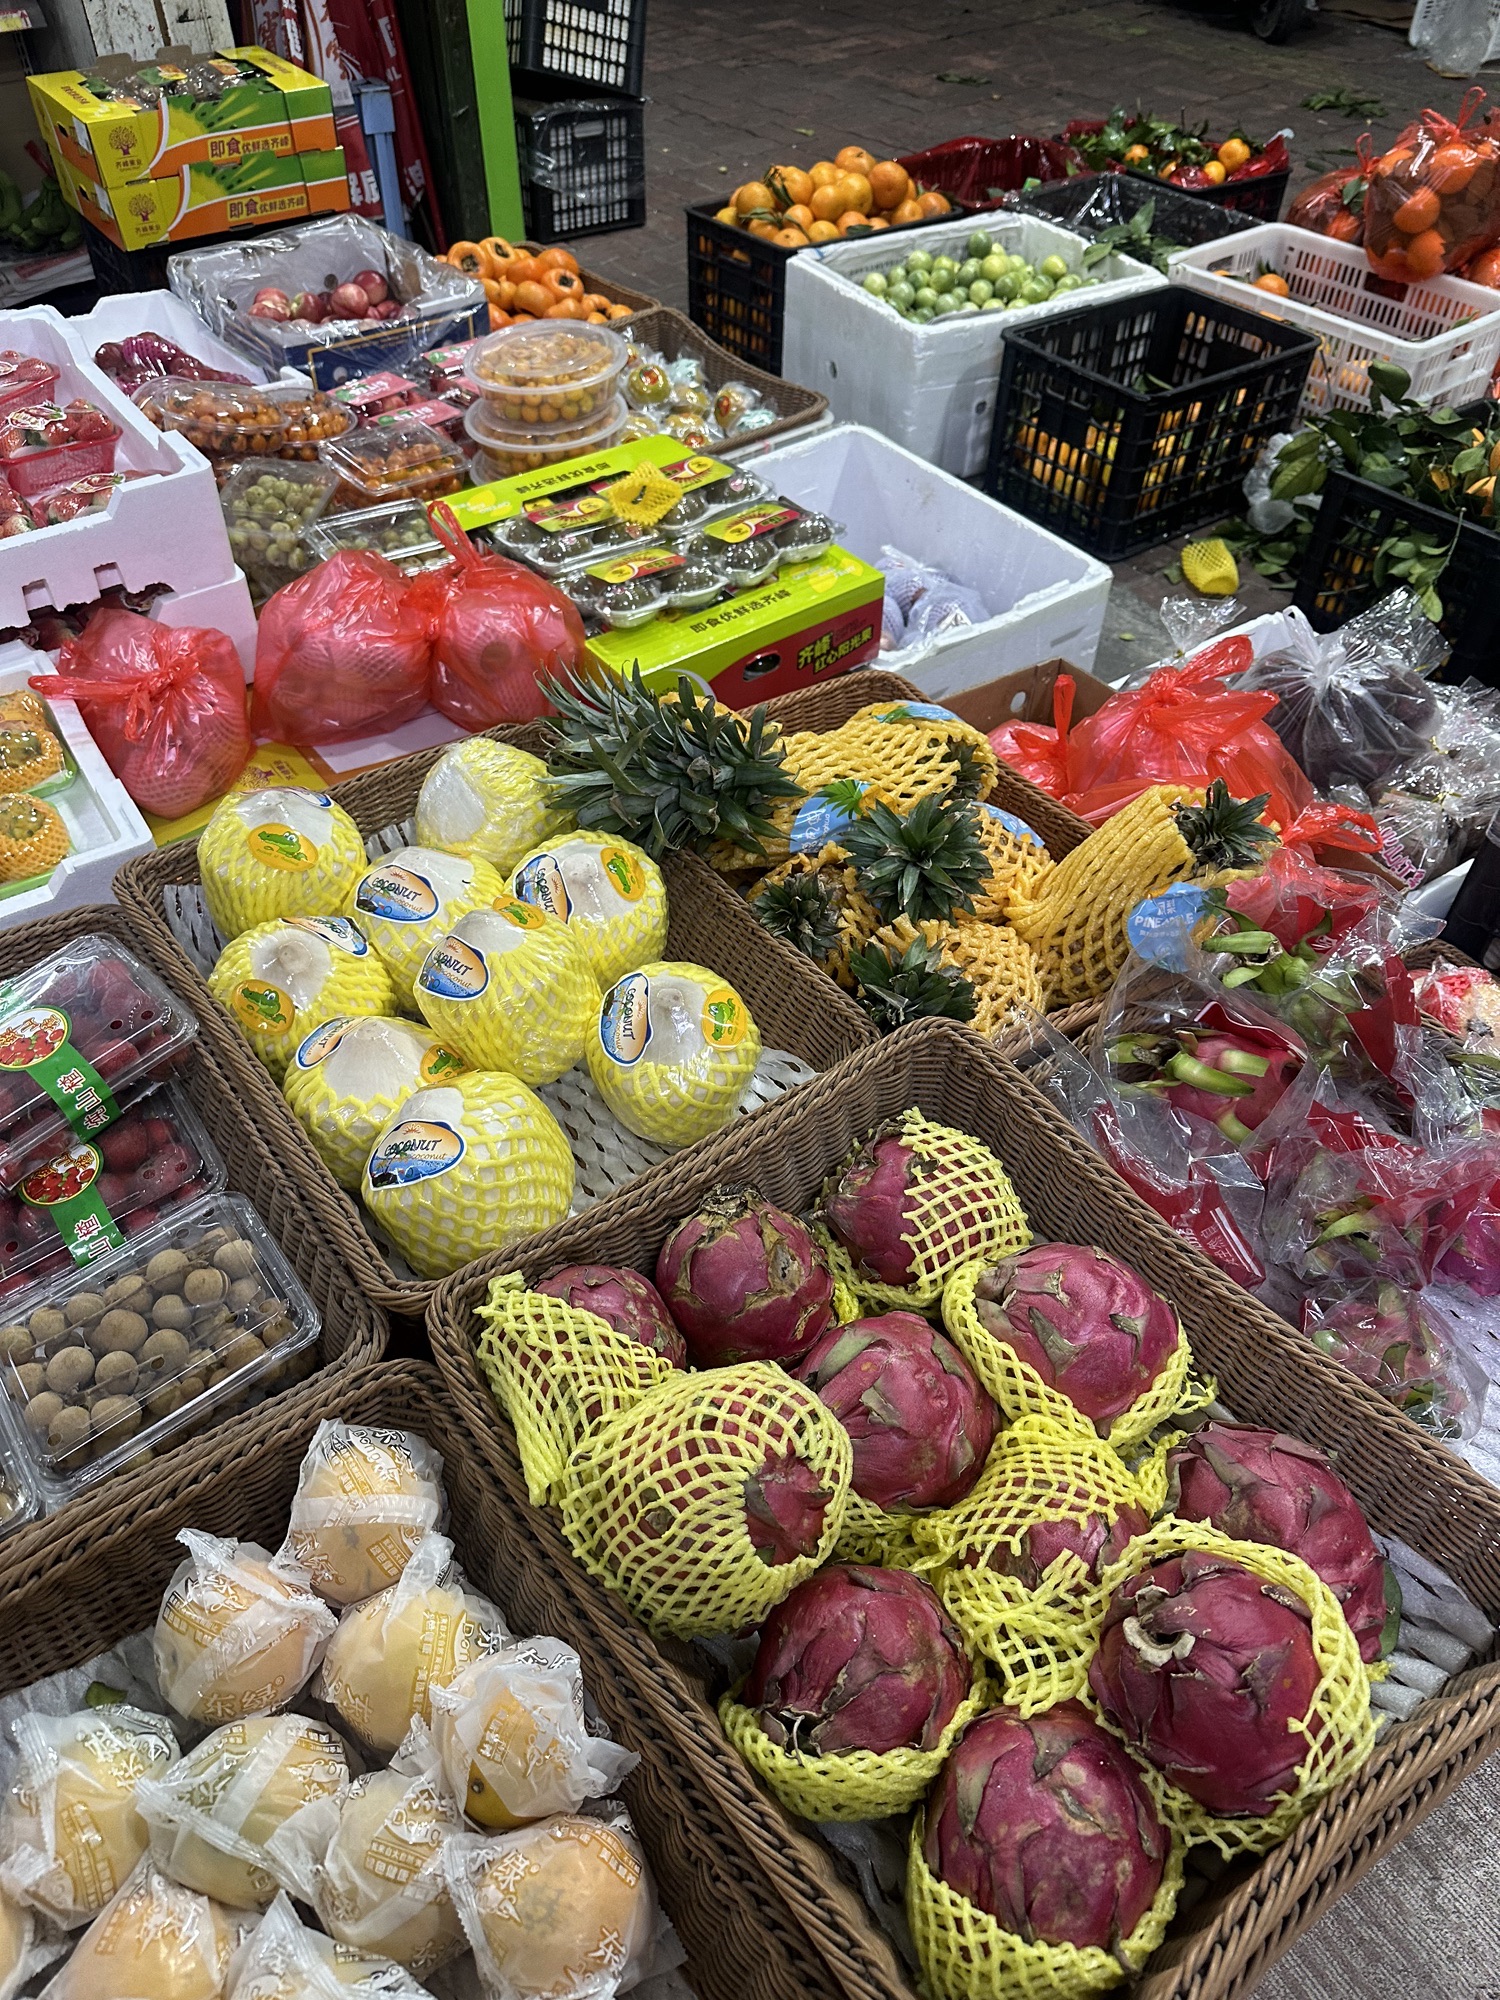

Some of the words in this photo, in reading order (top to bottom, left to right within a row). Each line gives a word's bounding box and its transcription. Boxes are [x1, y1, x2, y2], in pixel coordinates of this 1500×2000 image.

[690, 588, 792, 633] 即食优鲜选齐峰
[798, 633, 832, 670] 齐峰
[371, 877, 422, 901] COCONUT
[384, 1138, 442, 1157] COCONUT
